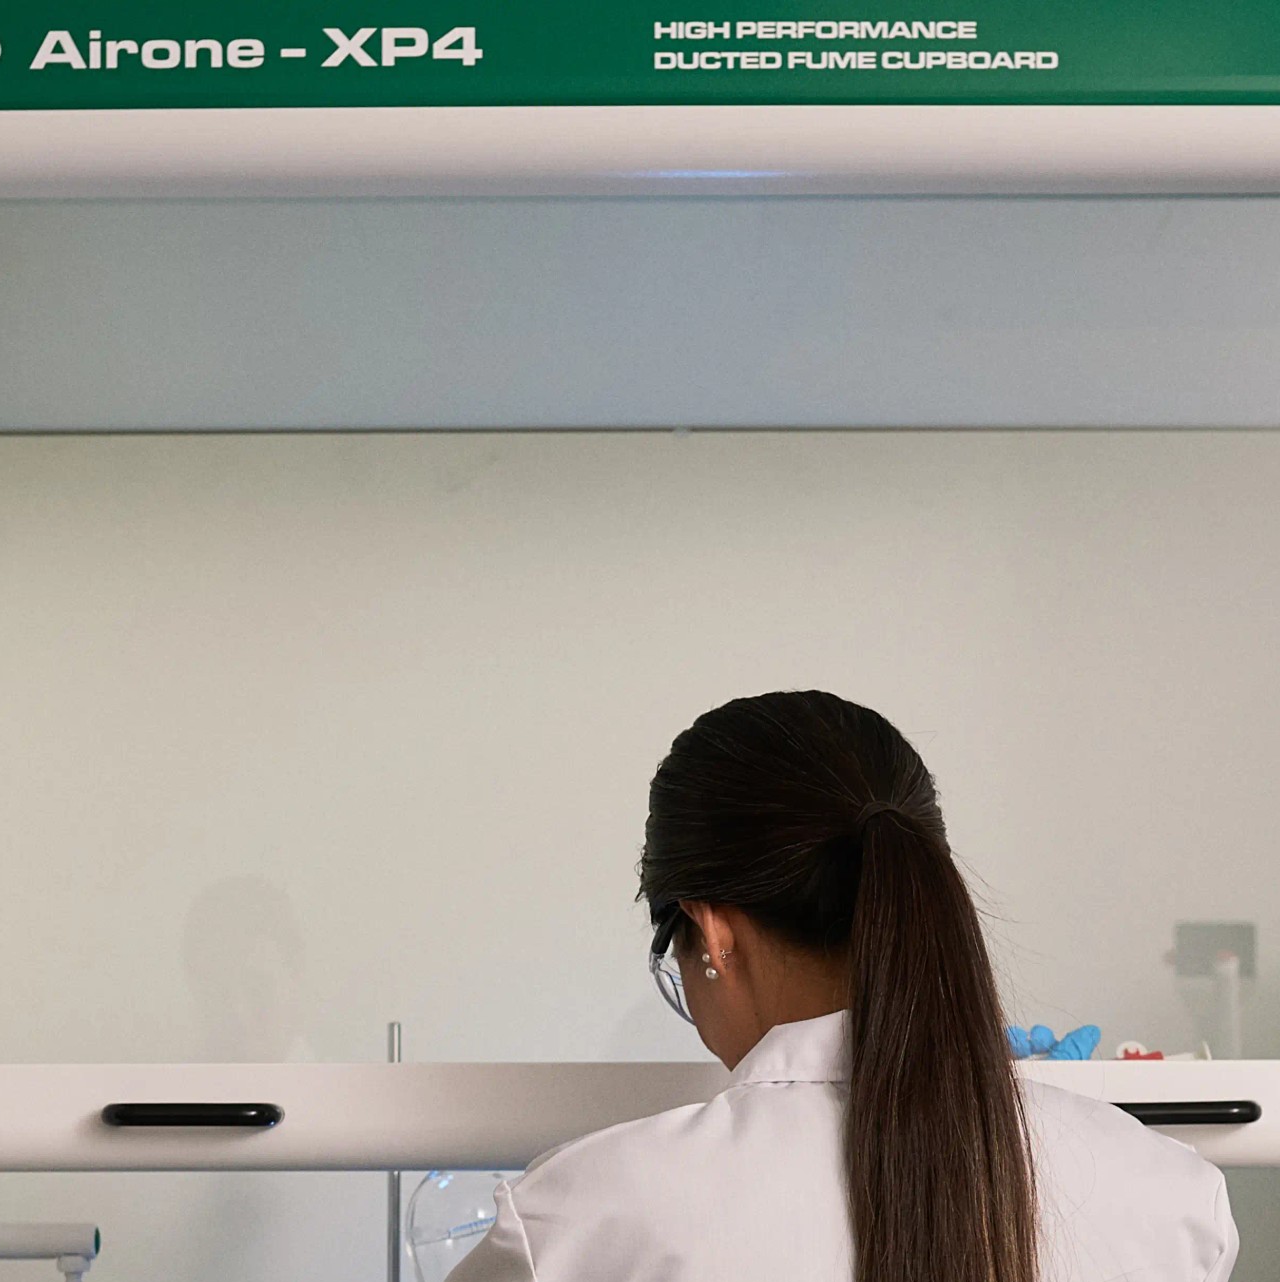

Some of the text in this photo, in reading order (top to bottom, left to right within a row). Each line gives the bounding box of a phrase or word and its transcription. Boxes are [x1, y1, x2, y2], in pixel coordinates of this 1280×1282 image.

[654, 21, 978, 40] HIGH PERFORMANCE
[29, 31, 264, 69] Airone
[322, 27, 482, 67] XP4
[654, 51, 1058, 69] DUCTED FUME CUPBOARD
